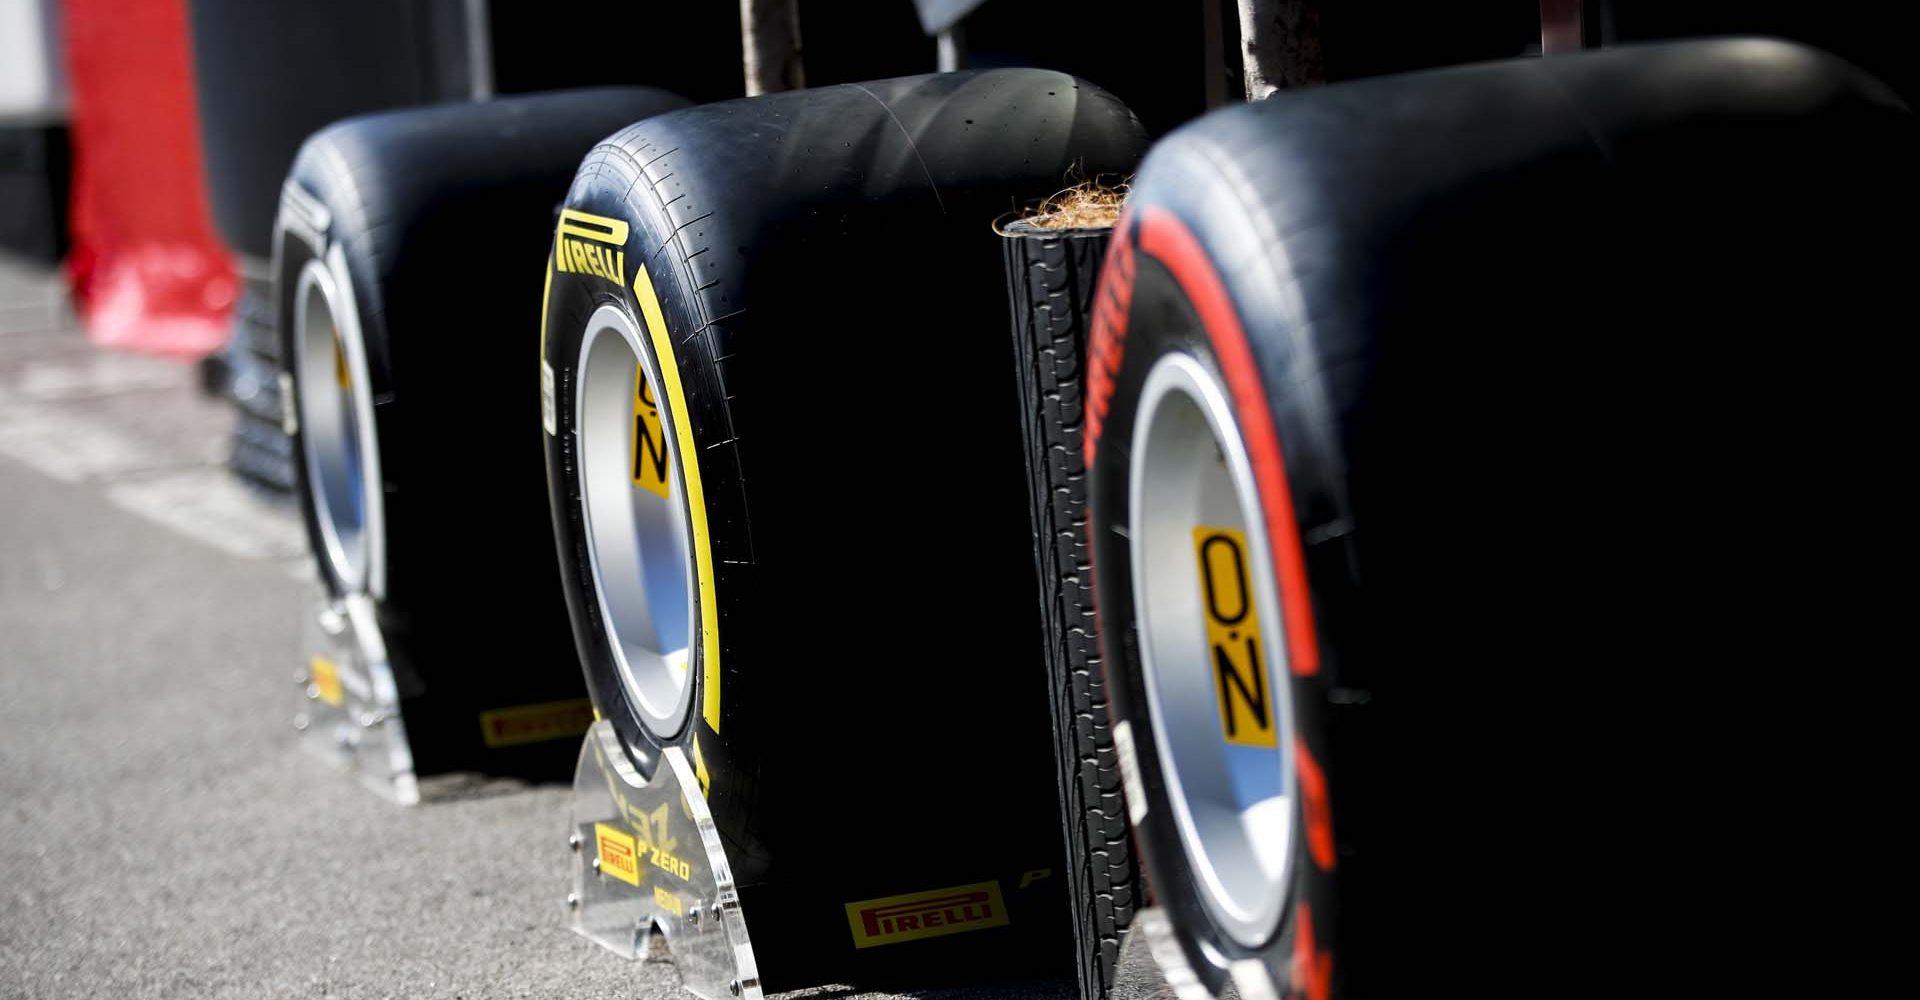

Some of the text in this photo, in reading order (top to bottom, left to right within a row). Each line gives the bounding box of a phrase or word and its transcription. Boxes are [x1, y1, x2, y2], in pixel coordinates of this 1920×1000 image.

[556, 208, 629, 287] PIRELLI
[601, 837, 634, 873] PIRELLI
[651, 847, 690, 882] ZERO
[860, 891, 992, 937] PIRELLI
